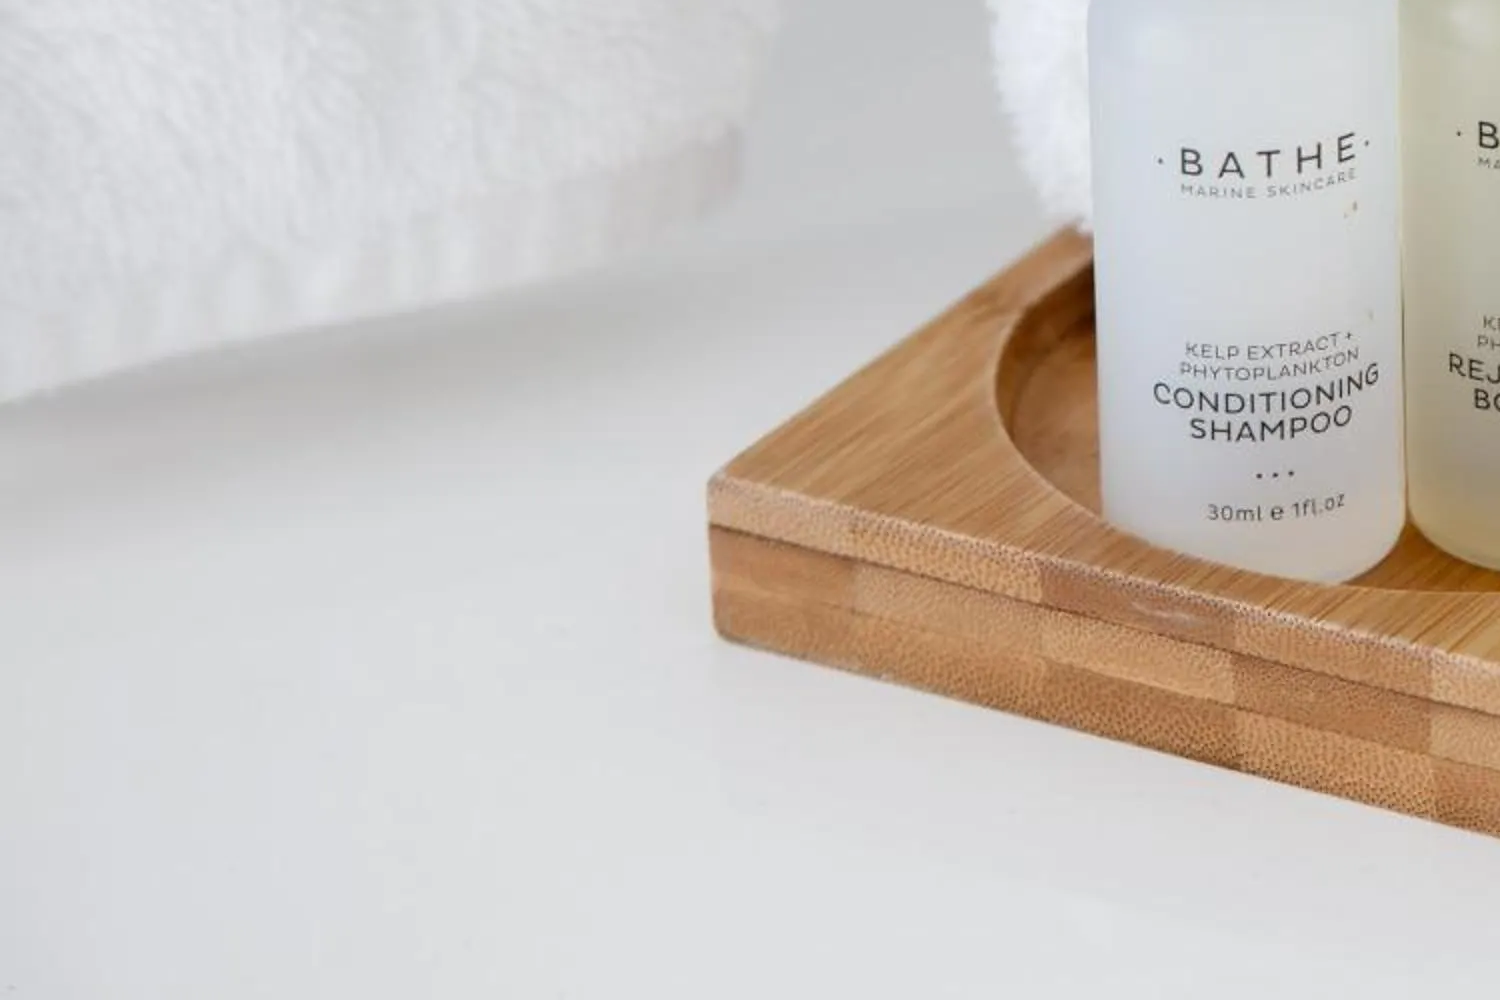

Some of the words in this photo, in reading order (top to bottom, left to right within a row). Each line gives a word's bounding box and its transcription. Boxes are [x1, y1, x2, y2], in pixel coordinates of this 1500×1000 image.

[1180, 132, 1356, 178] BATHE
[1180, 183, 1257, 199] MARINE
[1266, 167, 1357, 198] SKINCARE
[1179, 346, 1360, 381] PHYTOPLANKTON
[1185, 341, 1240, 361] KELP
[1247, 331, 1341, 361] EXTRACT
[1153, 362, 1380, 415] CONDITIONING
[1189, 404, 1353, 443] SHAMPOO
[1206, 503, 1263, 522] 30ml
